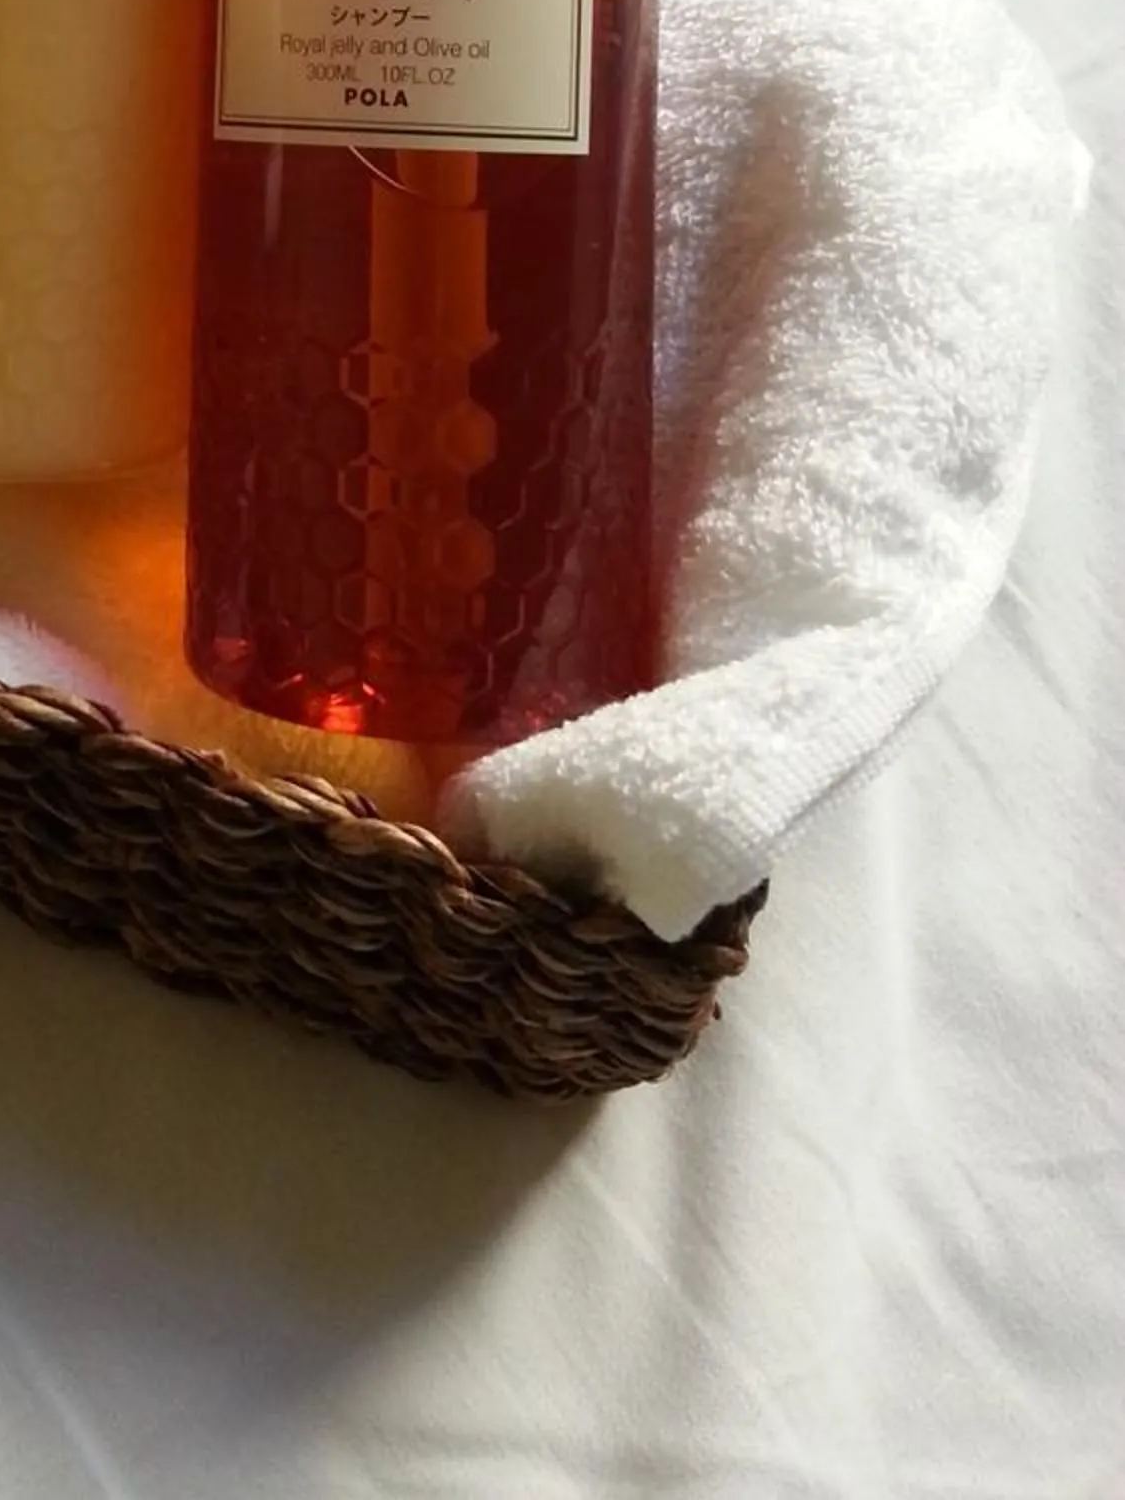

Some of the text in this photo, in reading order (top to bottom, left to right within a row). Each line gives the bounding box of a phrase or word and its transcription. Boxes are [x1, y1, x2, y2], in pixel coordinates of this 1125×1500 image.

[280, 33, 490, 59] Royal jelly and Olive oil
[344, 87, 409, 109] POLA
